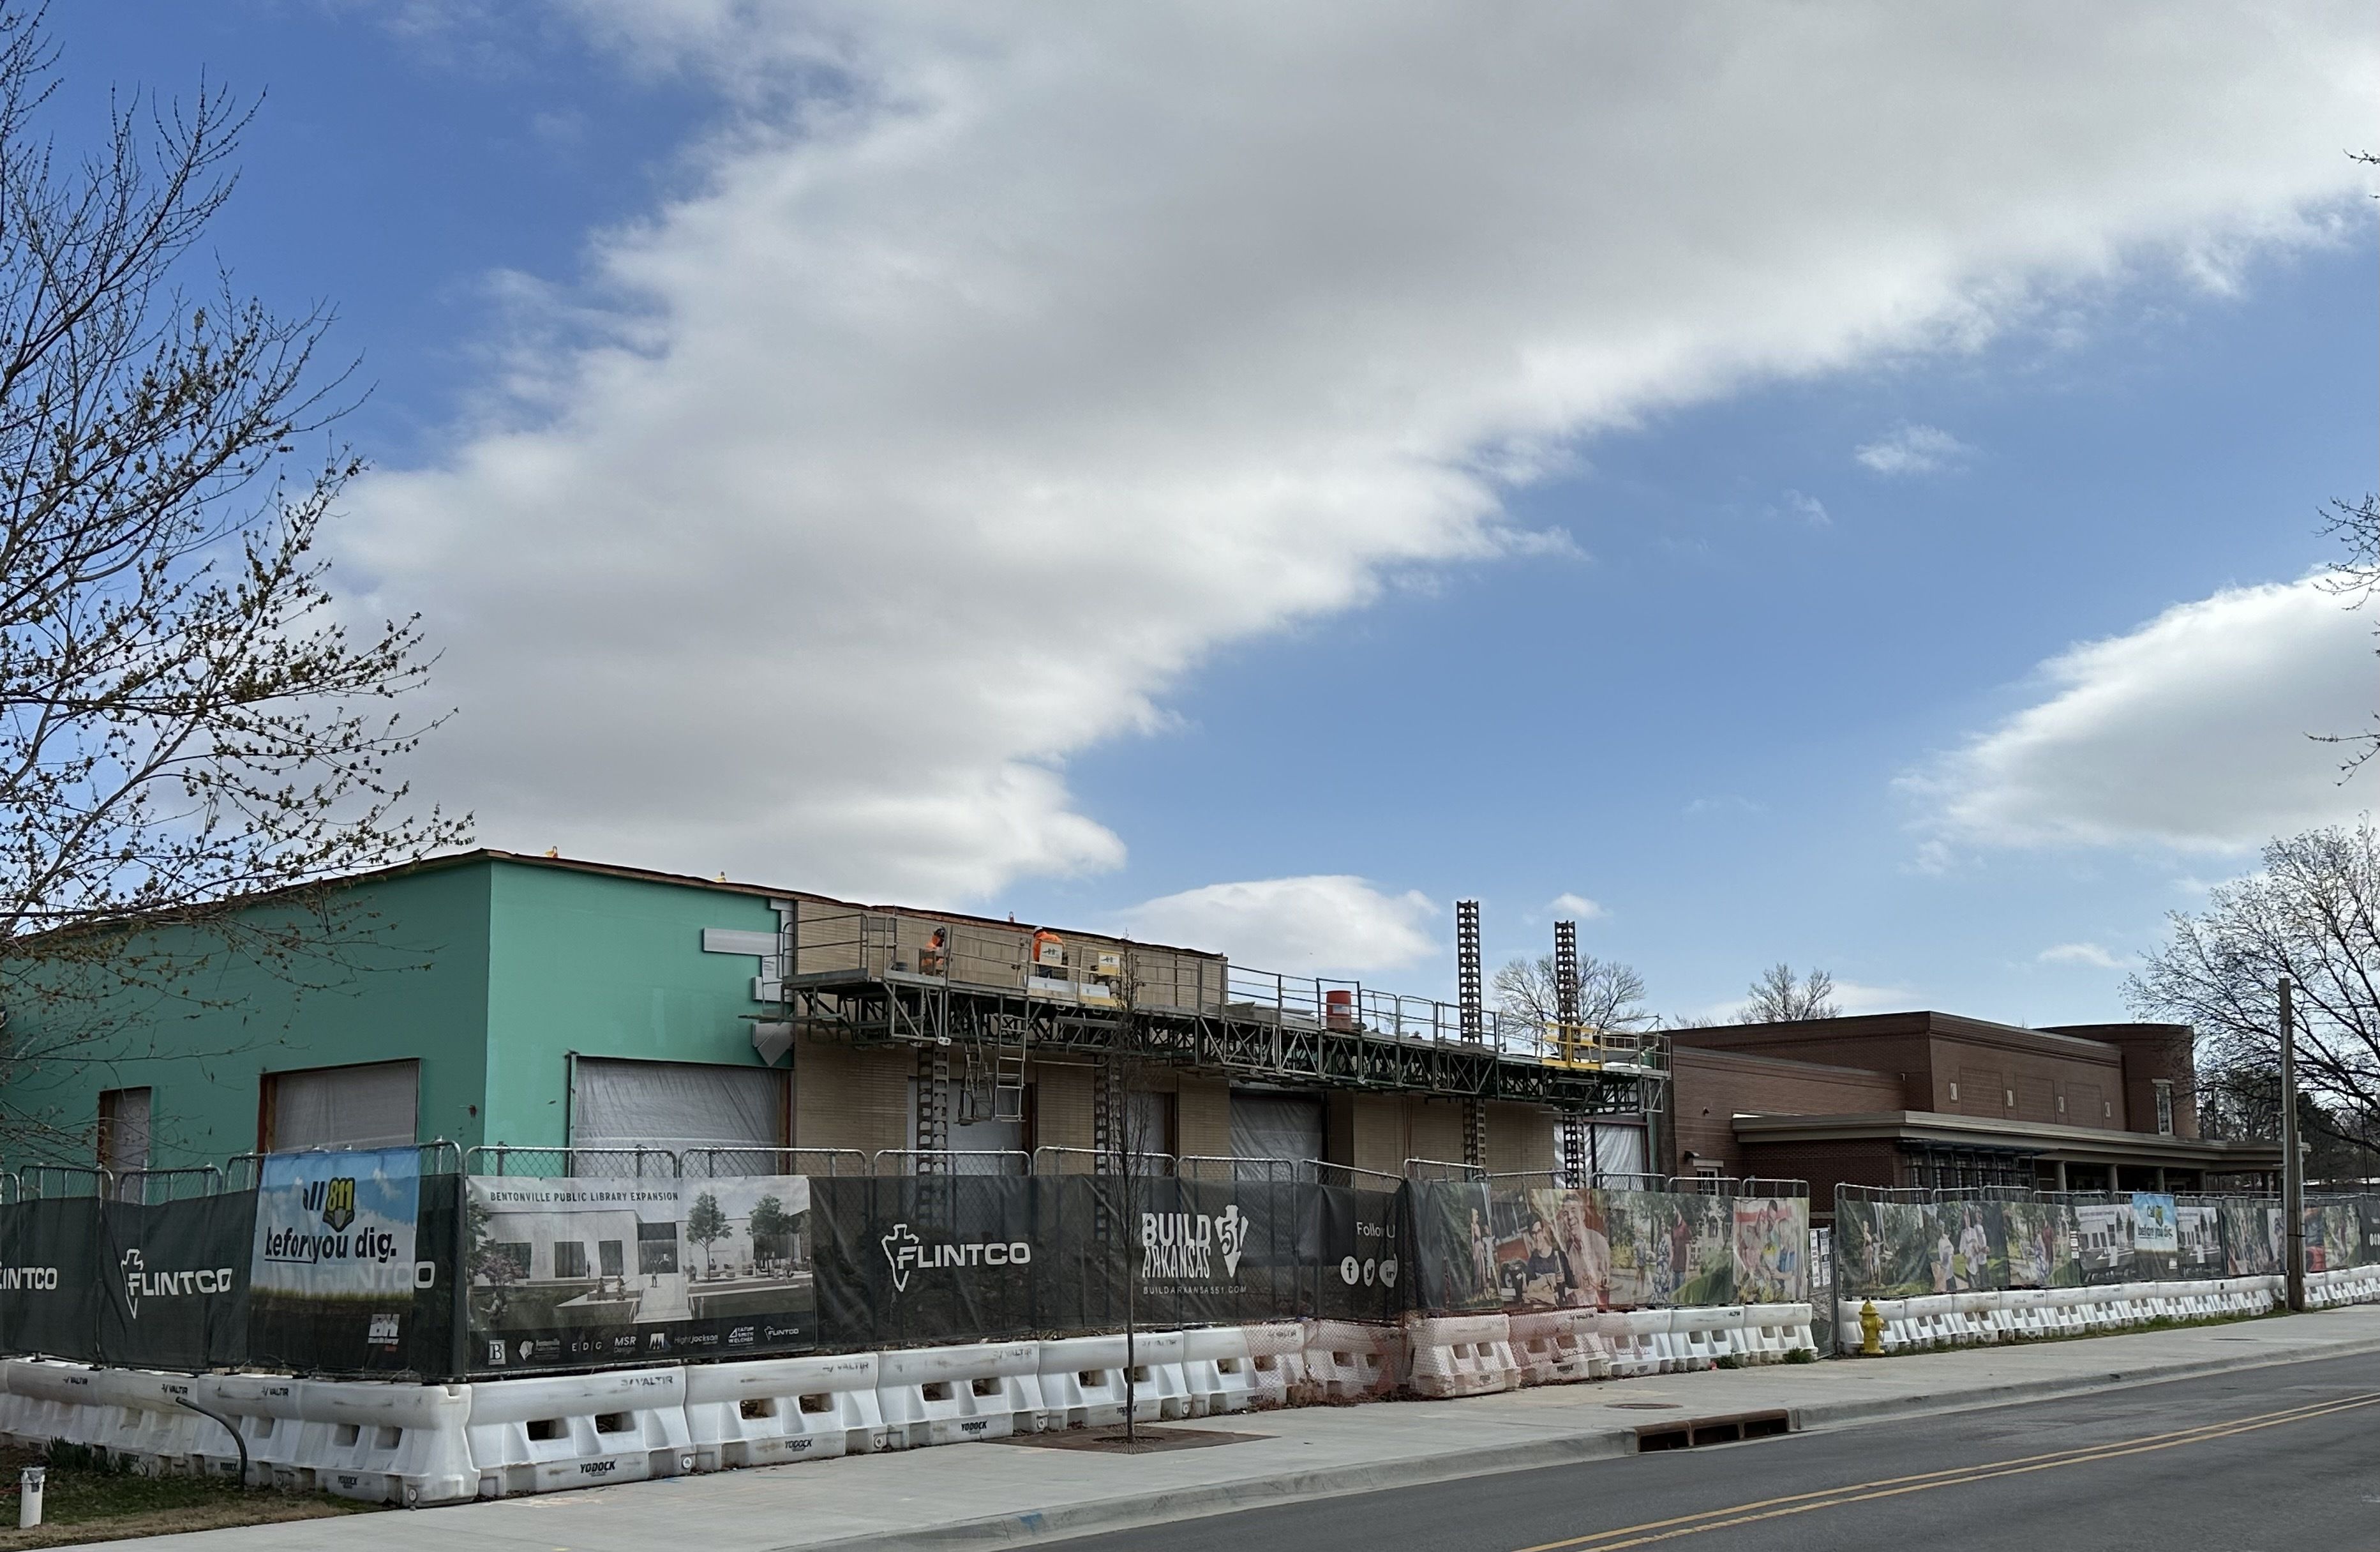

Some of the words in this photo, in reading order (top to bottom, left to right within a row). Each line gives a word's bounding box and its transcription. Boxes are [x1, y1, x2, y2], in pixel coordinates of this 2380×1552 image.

[326, 1179, 355, 1212] 811
[490, 1191, 551, 1202] BENTONVILLE
[553, 1192, 587, 1202] PUBLIC
[590, 1192, 627, 1202] LIBRARY
[630, 1191, 678, 1202] EXPANSION
[1142, 1212, 1211, 1246] BUILD
[312, 1235, 348, 1264] you
[355, 1226, 397, 1263] dig.
[897, 1242, 1031, 1270] FLINTCO
[1142, 1245, 1211, 1279] ARKANSAS
[128, 1268, 233, 1297] FLINTCO
[614, 1336, 637, 1346] MSR
[768, 1328, 800, 1336] FLINTCO
[580, 1458, 617, 1473] YODOCK
